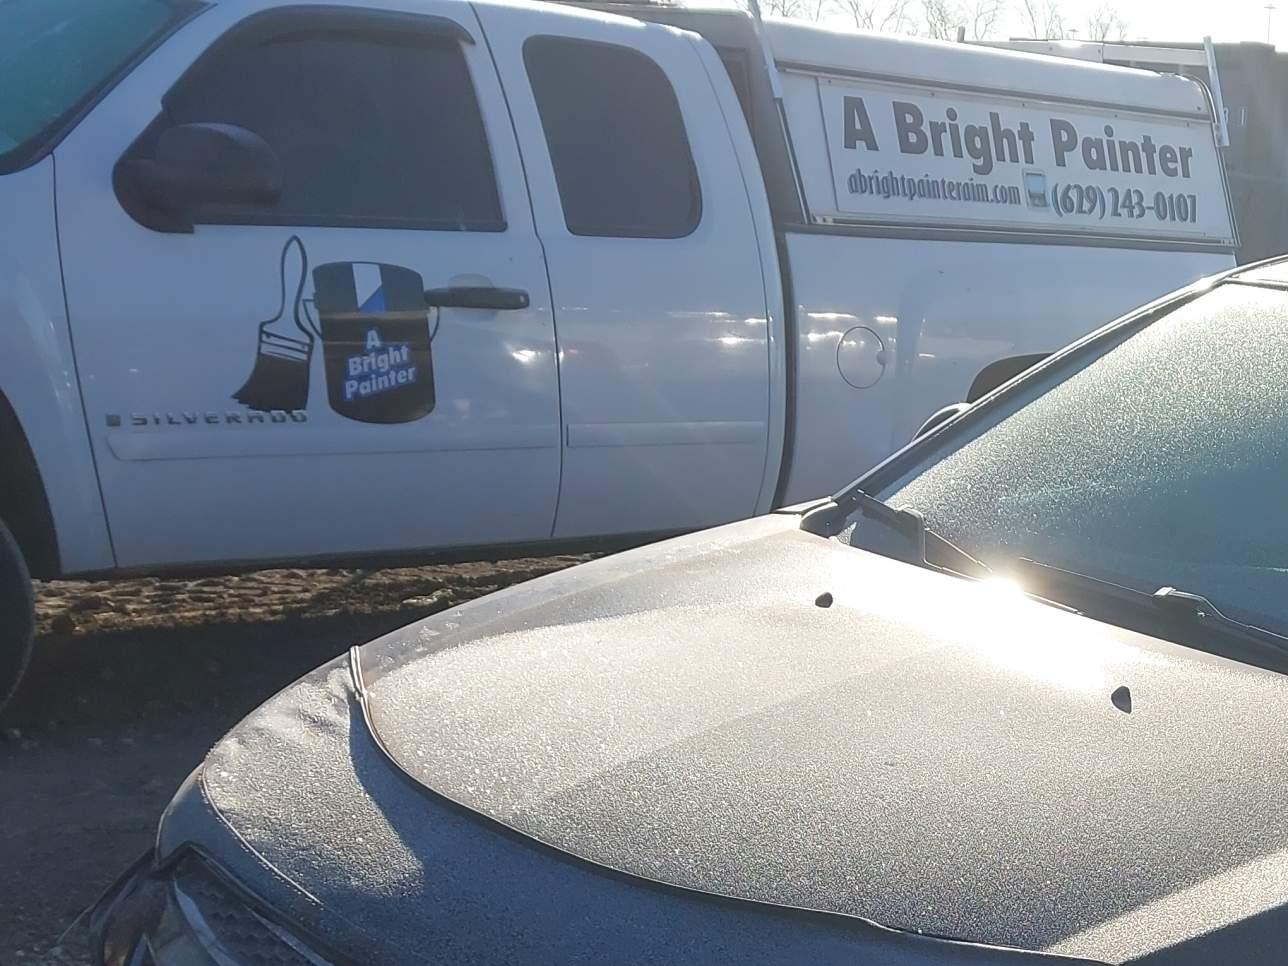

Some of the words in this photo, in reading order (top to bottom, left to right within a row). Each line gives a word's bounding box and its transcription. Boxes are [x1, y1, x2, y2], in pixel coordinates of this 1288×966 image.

[843, 96, 880, 151] A
[893, 101, 1035, 176] Bright
[1050, 119, 1193, 178] Painter
[1052, 183, 1106, 219] (629)
[1109, 188, 1198, 224] 243-0107
[366, 328, 381, 350] A
[348, 344, 409, 376] Bright
[345, 367, 417, 400] Painter
[130, 410, 308, 426] SILVERADO
